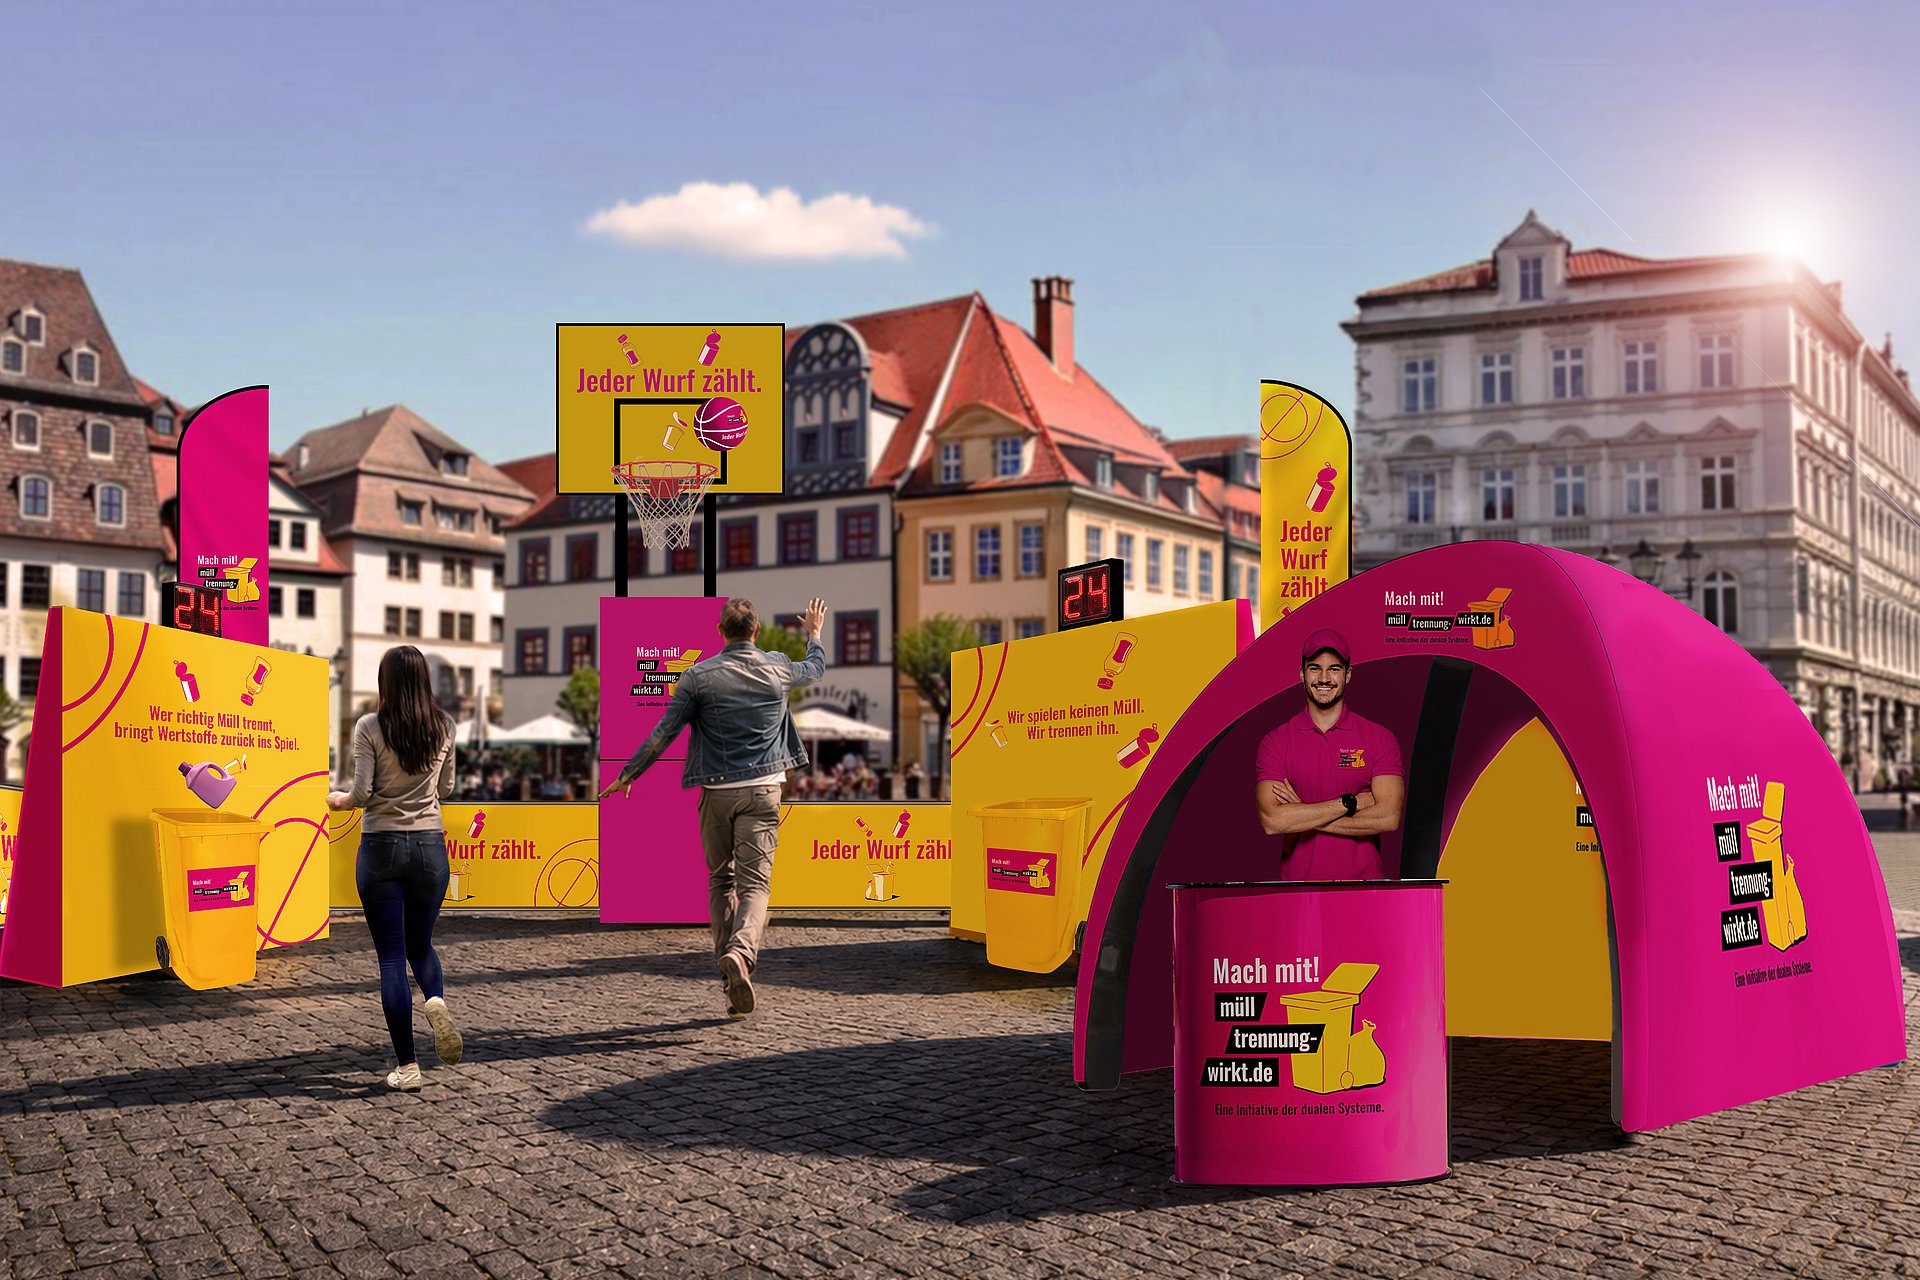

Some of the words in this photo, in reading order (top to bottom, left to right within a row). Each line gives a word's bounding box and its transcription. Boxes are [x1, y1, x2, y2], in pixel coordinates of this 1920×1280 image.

[576, 368, 635, 393] Jeder
[643, 368, 696, 392] Wurf
[702, 368, 762, 392] zählt.
[1280, 520, 1332, 542] Jeder
[198, 555, 218, 565] Mach
[222, 555, 238, 565] mit!
[1281, 549, 1328, 570] Wurf
[200, 568, 215, 576] müll
[205, 580, 236, 588] trennung-
[1064, 574, 1107, 618] 24
[1385, 591, 1416, 606] Mach
[1420, 591, 1444, 606] mit!
[174, 587, 219, 631] 24
[1388, 614, 1406, 625] müll
[1412, 618, 1452, 630] trennung-
[1458, 614, 1491, 625] wirkt.de
[636, 647, 660, 657] Mach
[662, 647, 680, 657] mit!
[640, 661, 655, 670] müll
[645, 674, 679, 683] trennung-
[633, 686, 662, 694] wirkt.de
[149, 705, 173, 722] Wer
[177, 709, 214, 729] richtig
[218, 713, 240, 728] Müll
[243, 717, 275, 734] trennt,
[1007, 711, 1024, 724] Wir
[1028, 707, 1066, 725] spielen
[1070, 704, 1108, 719] keinen
[1114, 698, 1144, 715] Müll.
[114, 722, 153, 742] bringt
[158, 726, 217, 745] Wertstoffe
[221, 733, 255, 748] zurück
[257, 735, 272, 749] ins
[274, 736, 300, 752] Spiel.
[1027, 726, 1045, 740] Wir
[1048, 723, 1092, 738] trennen
[1096, 720, 1119, 735] ihn.
[1706, 776, 1738, 812] Mach
[1739, 774, 1762, 809] mit!
[446, 840, 485, 859] Wurf
[491, 840, 541, 859] zählt.
[811, 840, 860, 860] Jeder
[867, 840, 910, 859] Wurf
[1576, 842, 1589, 852] Eine
[1718, 827, 1738, 856] müll
[1731, 870, 1771, 897] trennung-
[1723, 913, 1758, 944] wirkt.de
[1213, 957, 1267, 984] Mach
[1275, 956, 1319, 983] mit!
[1220, 996, 1255, 1017] müll
[1234, 1029, 1317, 1052] trennung-
[1208, 1062, 1273, 1082] wirkt.de
[1215, 1103, 1233, 1116] Eine
[1236, 1103, 1278, 1116] Initiative
[1281, 1103, 1298, 1115] der
[1301, 1102, 1335, 1115] dualen
[1338, 1102, 1384, 1116] Systeme.
